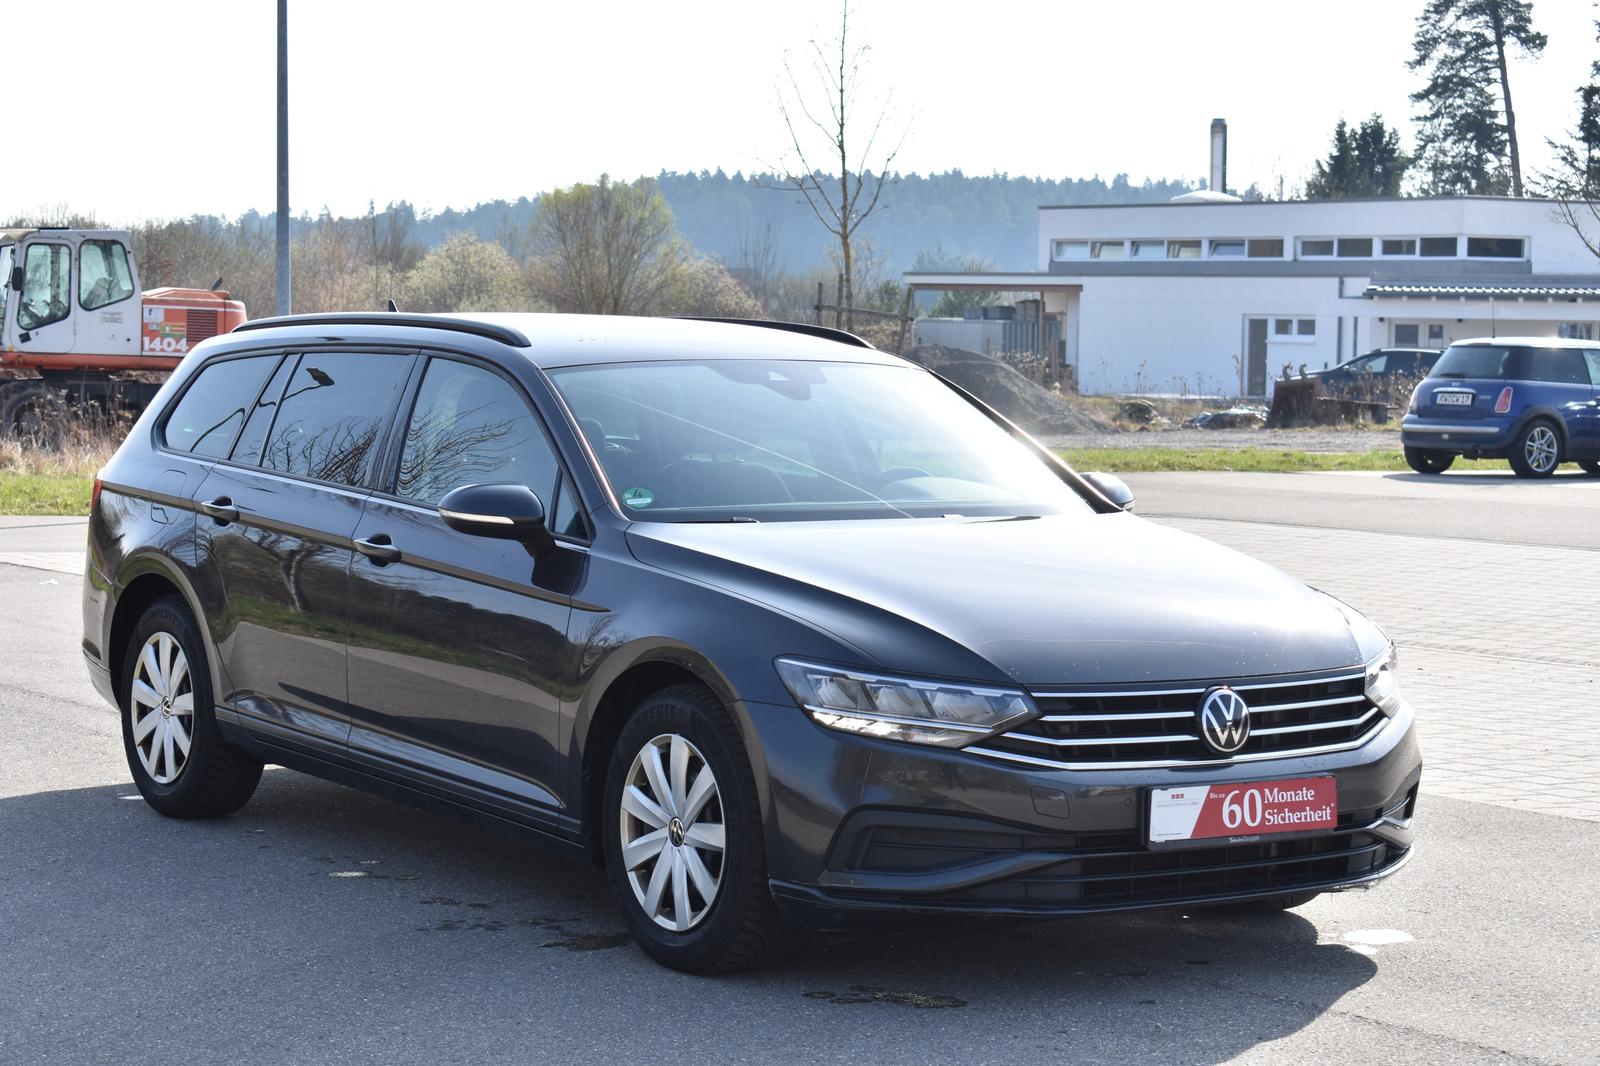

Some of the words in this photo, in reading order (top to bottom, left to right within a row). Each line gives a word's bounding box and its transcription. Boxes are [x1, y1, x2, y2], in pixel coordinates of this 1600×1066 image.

[143, 336, 189, 352] 1404
[1222, 789, 1262, 828] 60
[1264, 786, 1315, 804] Monate
